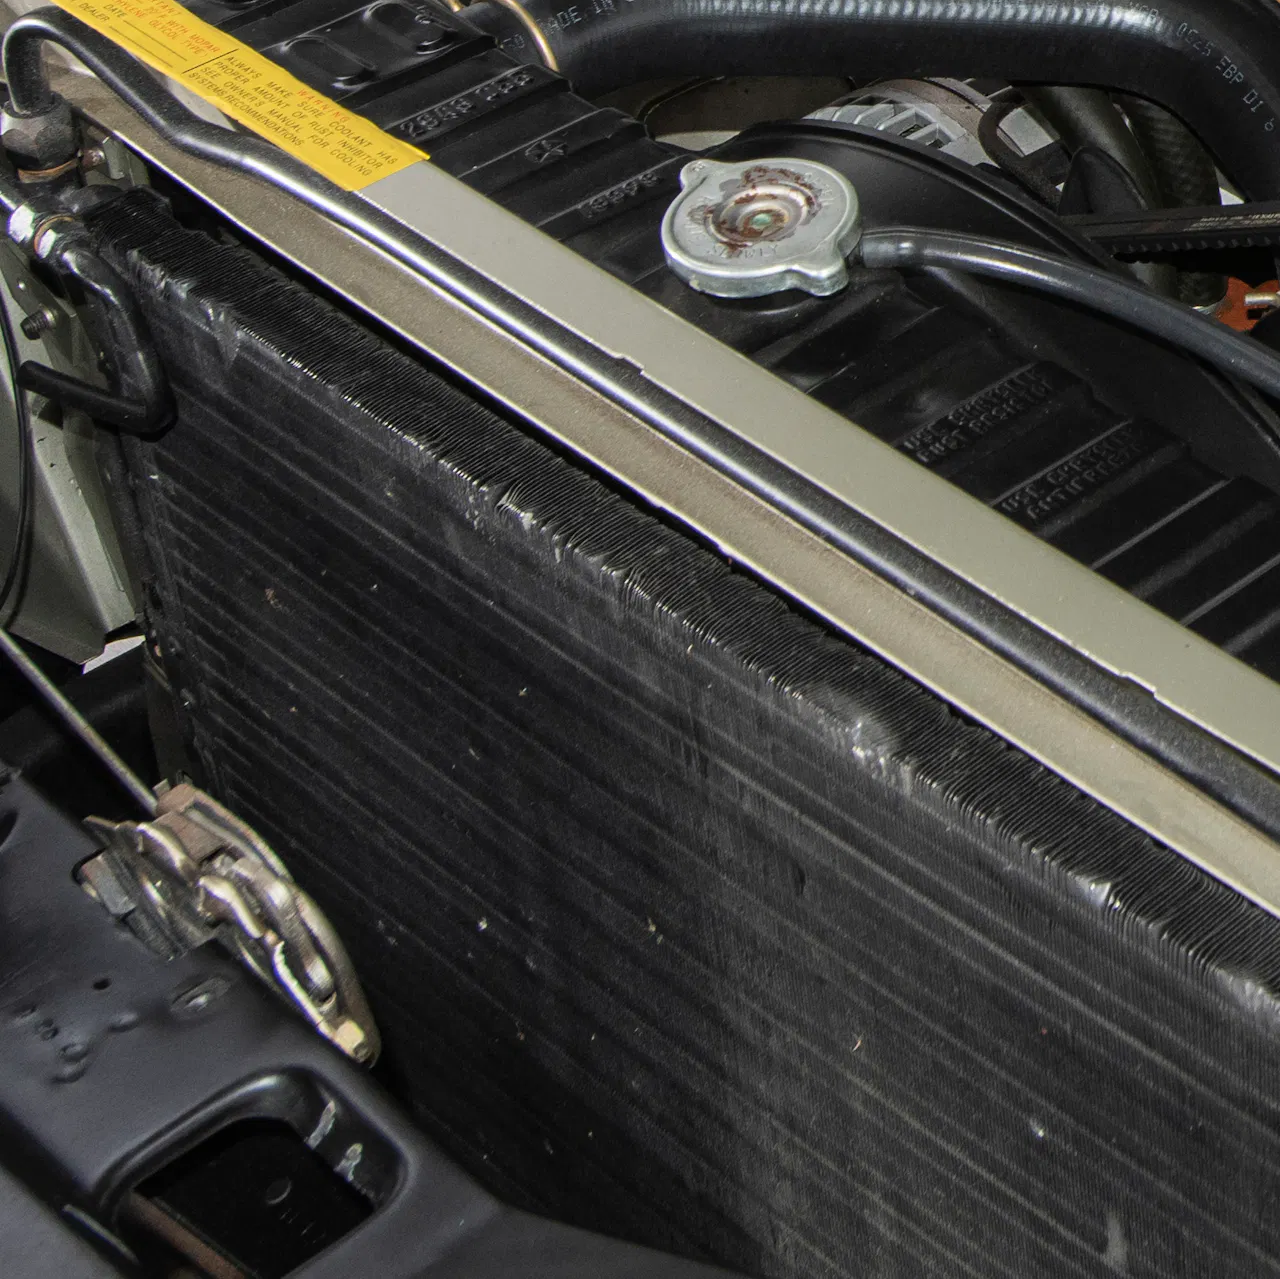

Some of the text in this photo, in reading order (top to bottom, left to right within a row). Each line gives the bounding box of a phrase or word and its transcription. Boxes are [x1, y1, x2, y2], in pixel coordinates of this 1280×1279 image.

[76, 1, 111, 23] DEALER
[101, 3, 127, 19] DATE
[145, 18, 181, 40] GLYCOL
[164, 18, 191, 34] WITH
[186, 32, 221, 54] MOPAR
[185, 71, 306, 147] SYSTEMS RECOMMENDATIONS
[199, 65, 374, 177] SEE OWNER'S MANUAL FOR COOLING
[210, 60, 385, 169] PROPER AMOUNT OF RUST INHIBITOR
[223, 54, 399, 165] ALWAYS MAKE SURE COOLANT HAS
[294, 87, 351, 123] WARNING
